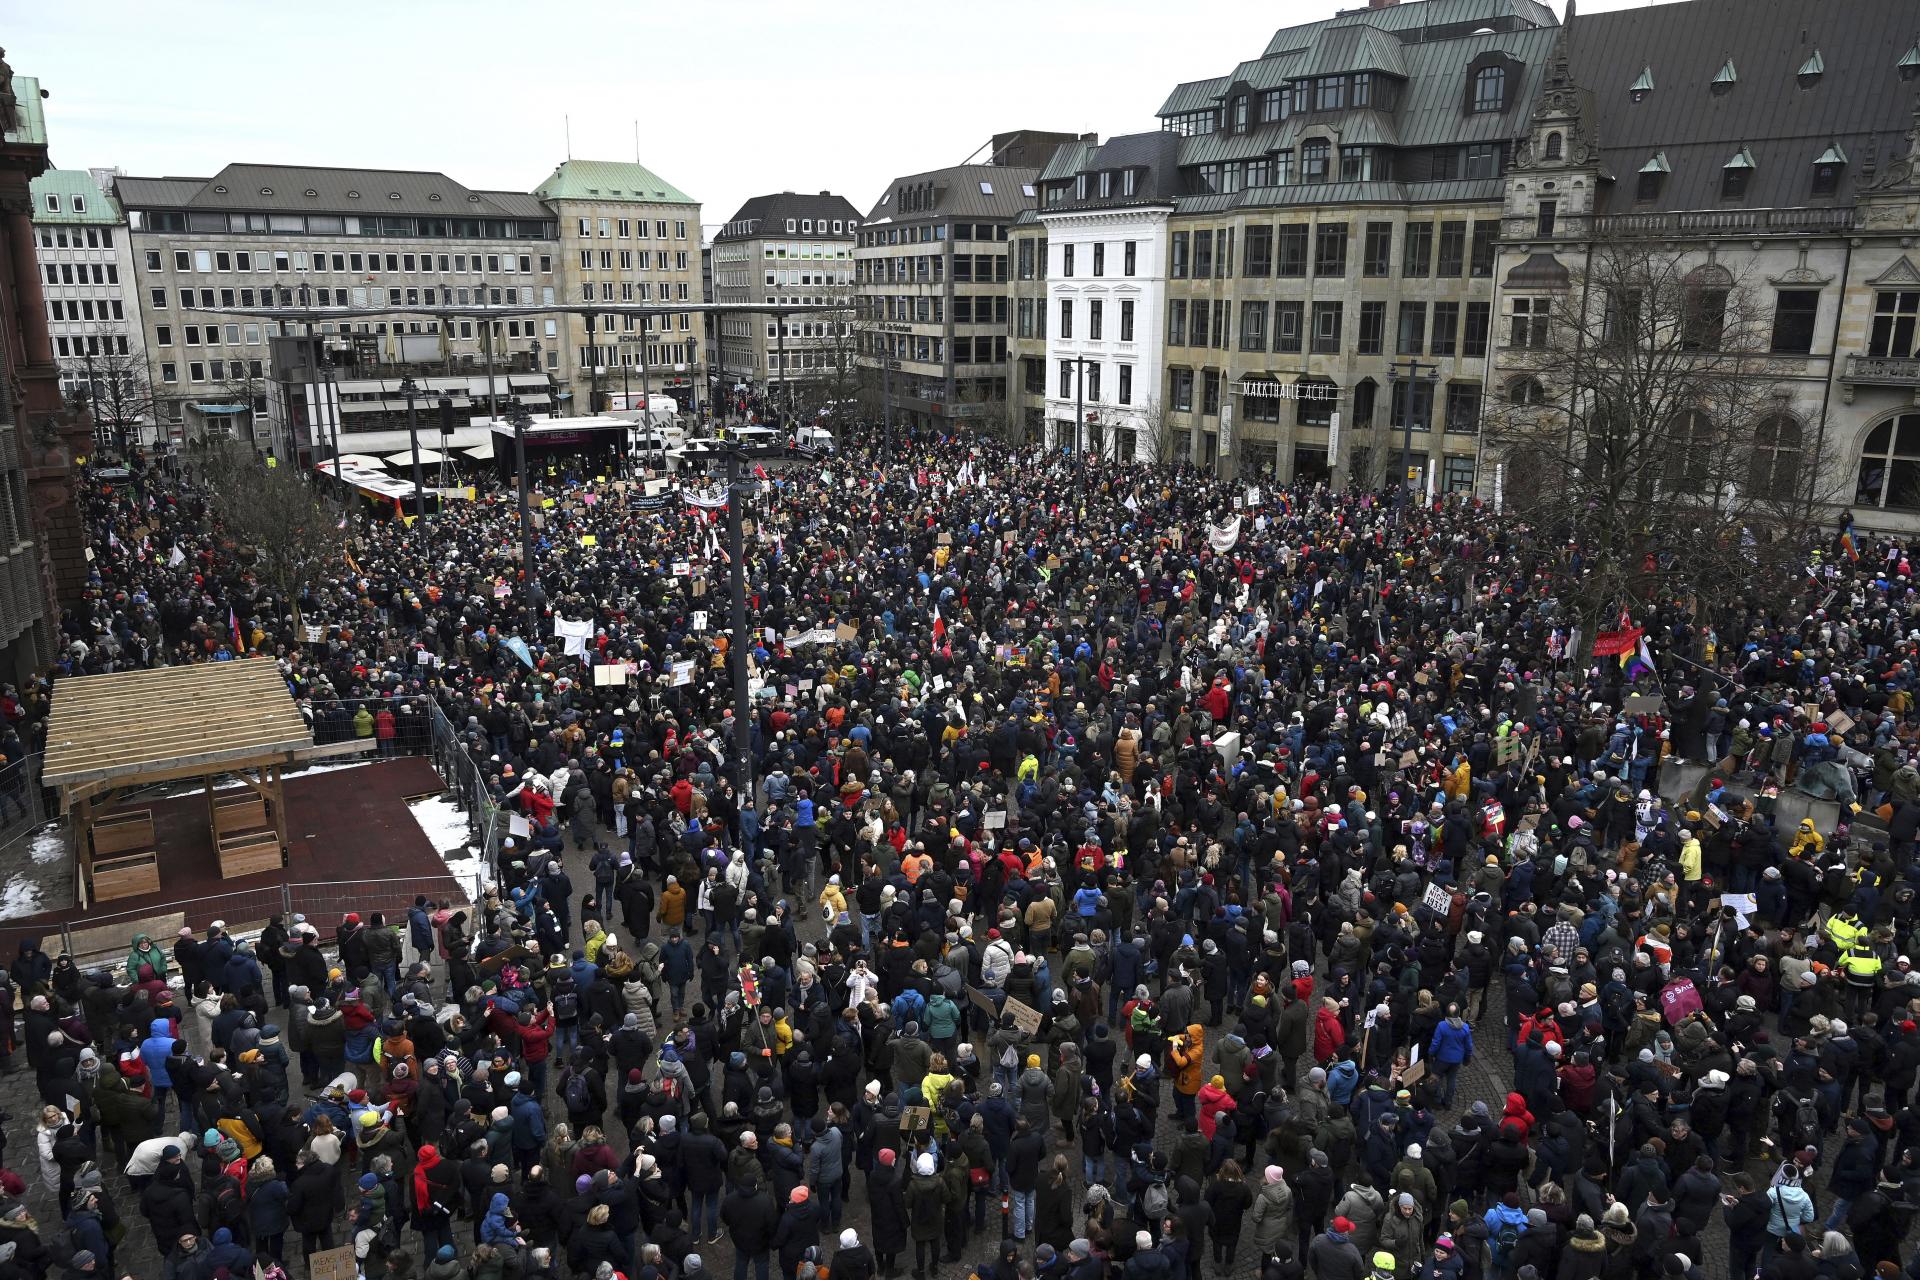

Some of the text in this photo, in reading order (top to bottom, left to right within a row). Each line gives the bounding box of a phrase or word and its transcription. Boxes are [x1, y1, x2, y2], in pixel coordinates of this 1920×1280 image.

[1242, 381, 1329, 401] MARKTHALLE ACHT
[1428, 889, 1449, 904] NICHT
[313, 1250, 353, 1266] MENSHEN
